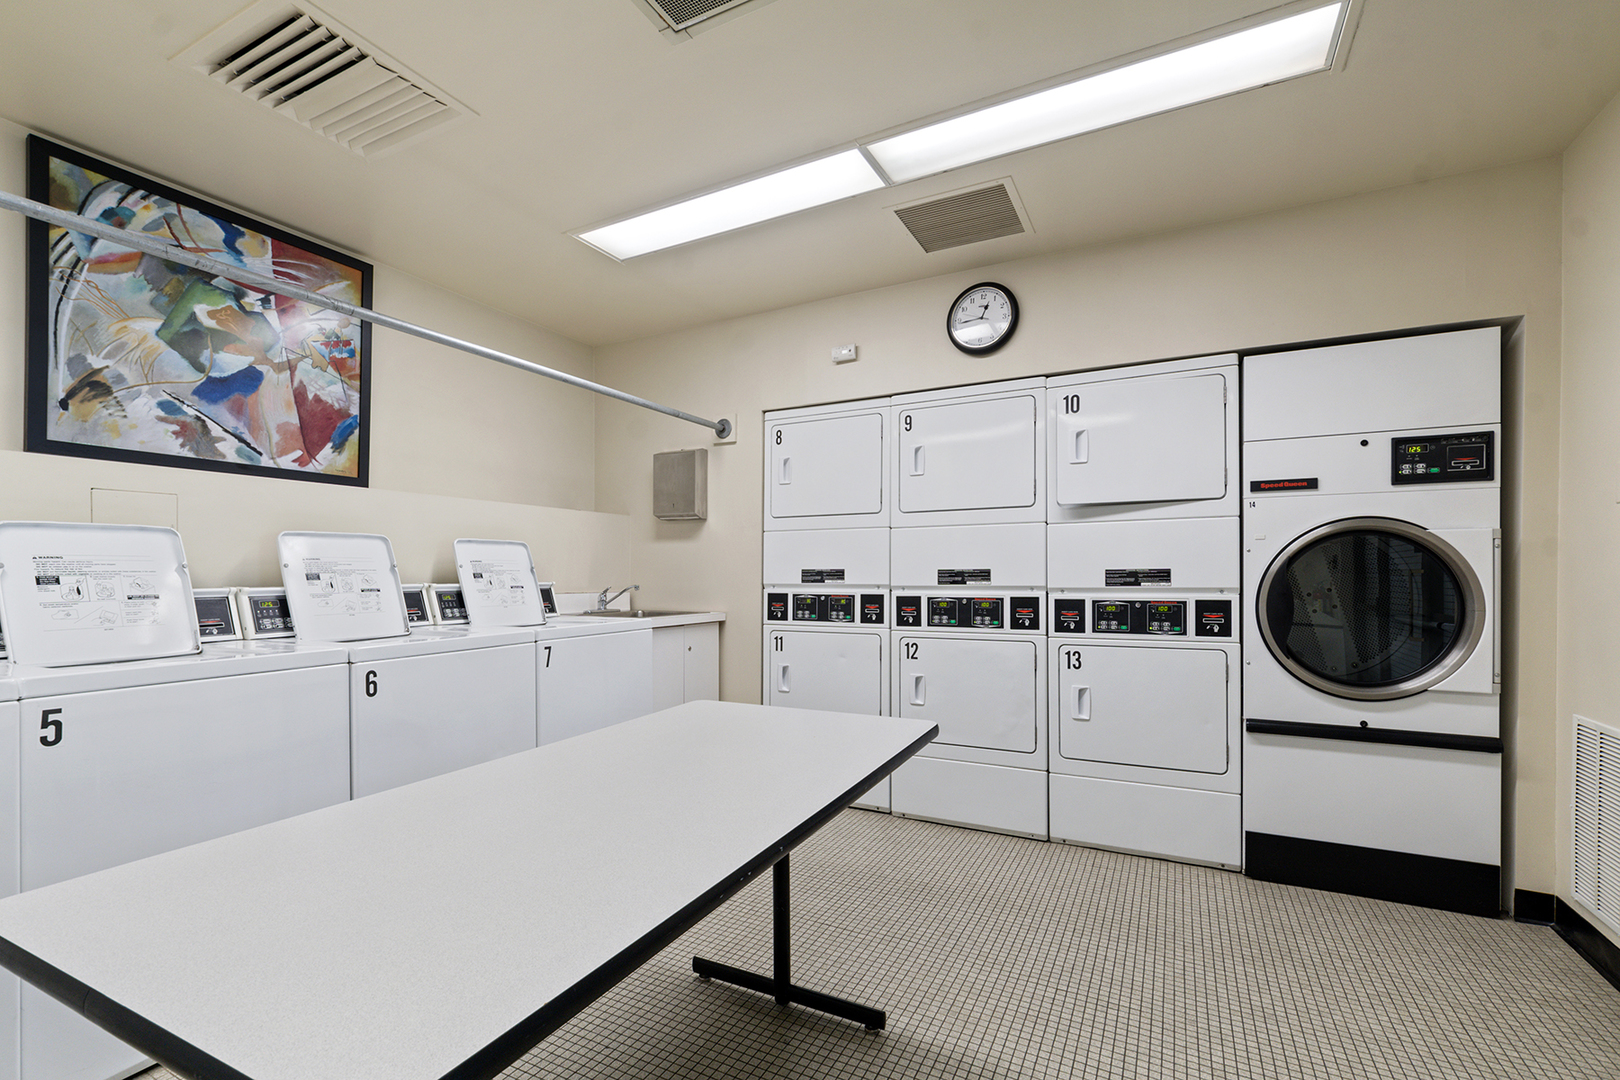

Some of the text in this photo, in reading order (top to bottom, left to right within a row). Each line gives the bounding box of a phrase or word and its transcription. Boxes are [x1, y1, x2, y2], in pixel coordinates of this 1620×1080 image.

[1063, 394, 1080, 414] 10
[904, 414, 912, 432] 9
[775, 429, 782, 446] 8
[1260, 481, 1284, 489] Speed
[773, 635, 783, 652] 11
[904, 642, 919, 660] 12
[544, 645, 552, 668] 7
[1064, 650, 1082, 670] 13
[365, 669, 378, 698] 6
[39, 707, 63, 747] 5
